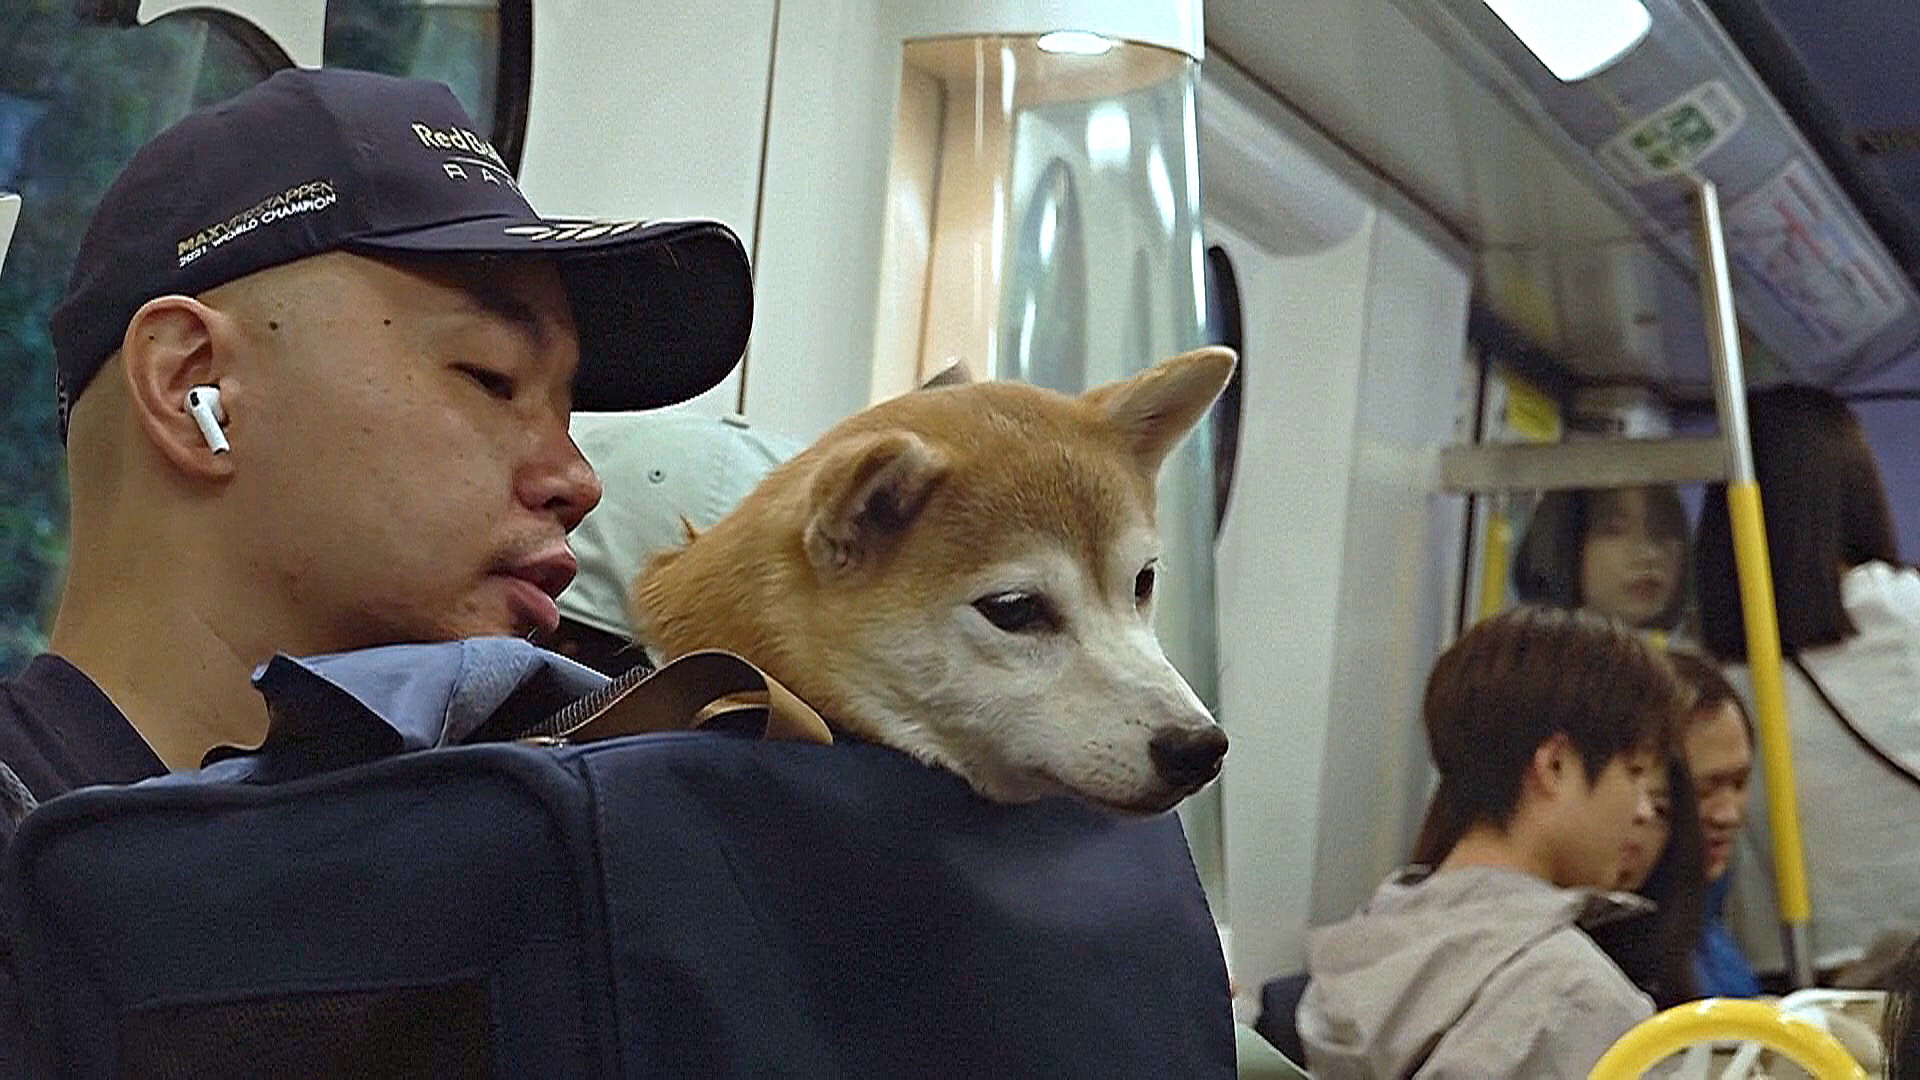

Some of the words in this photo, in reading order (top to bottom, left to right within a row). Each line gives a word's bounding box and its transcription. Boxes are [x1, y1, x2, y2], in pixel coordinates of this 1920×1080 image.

[179, 245, 207, 268] 2021
[212, 218, 258, 247] WORLD
[261, 192, 336, 223] CHAMPION
